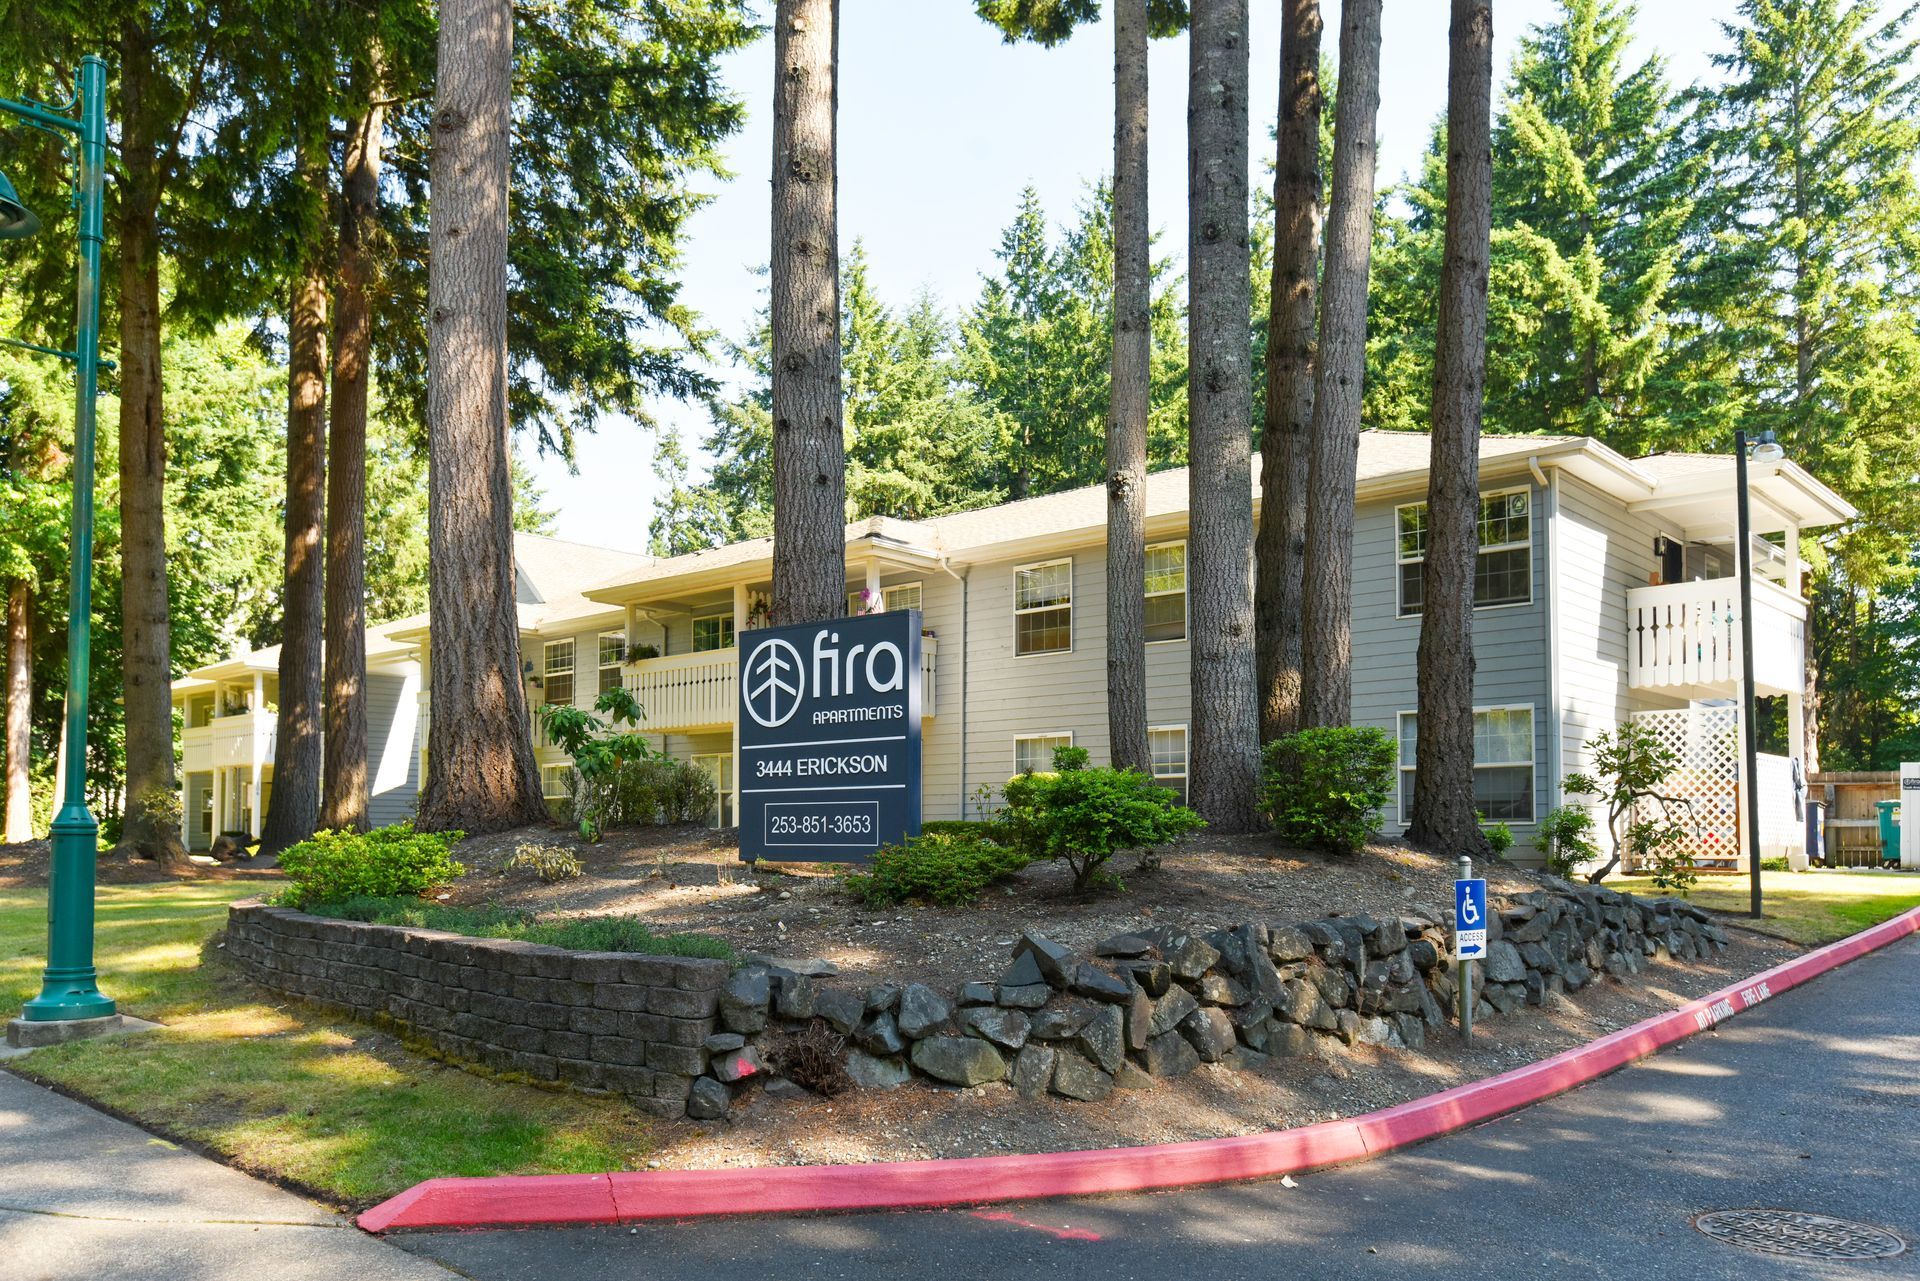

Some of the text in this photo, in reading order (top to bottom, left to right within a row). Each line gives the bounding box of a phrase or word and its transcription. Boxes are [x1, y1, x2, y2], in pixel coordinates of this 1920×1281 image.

[812, 629, 904, 698] fira
[812, 704, 904, 725] APARTMENTS
[756, 755, 888, 777] 3444 ERICKSON
[771, 814, 872, 834] 253-851-3653
[1459, 931, 1484, 942] ACCESS
[1704, 998, 1735, 1025] PARKING
